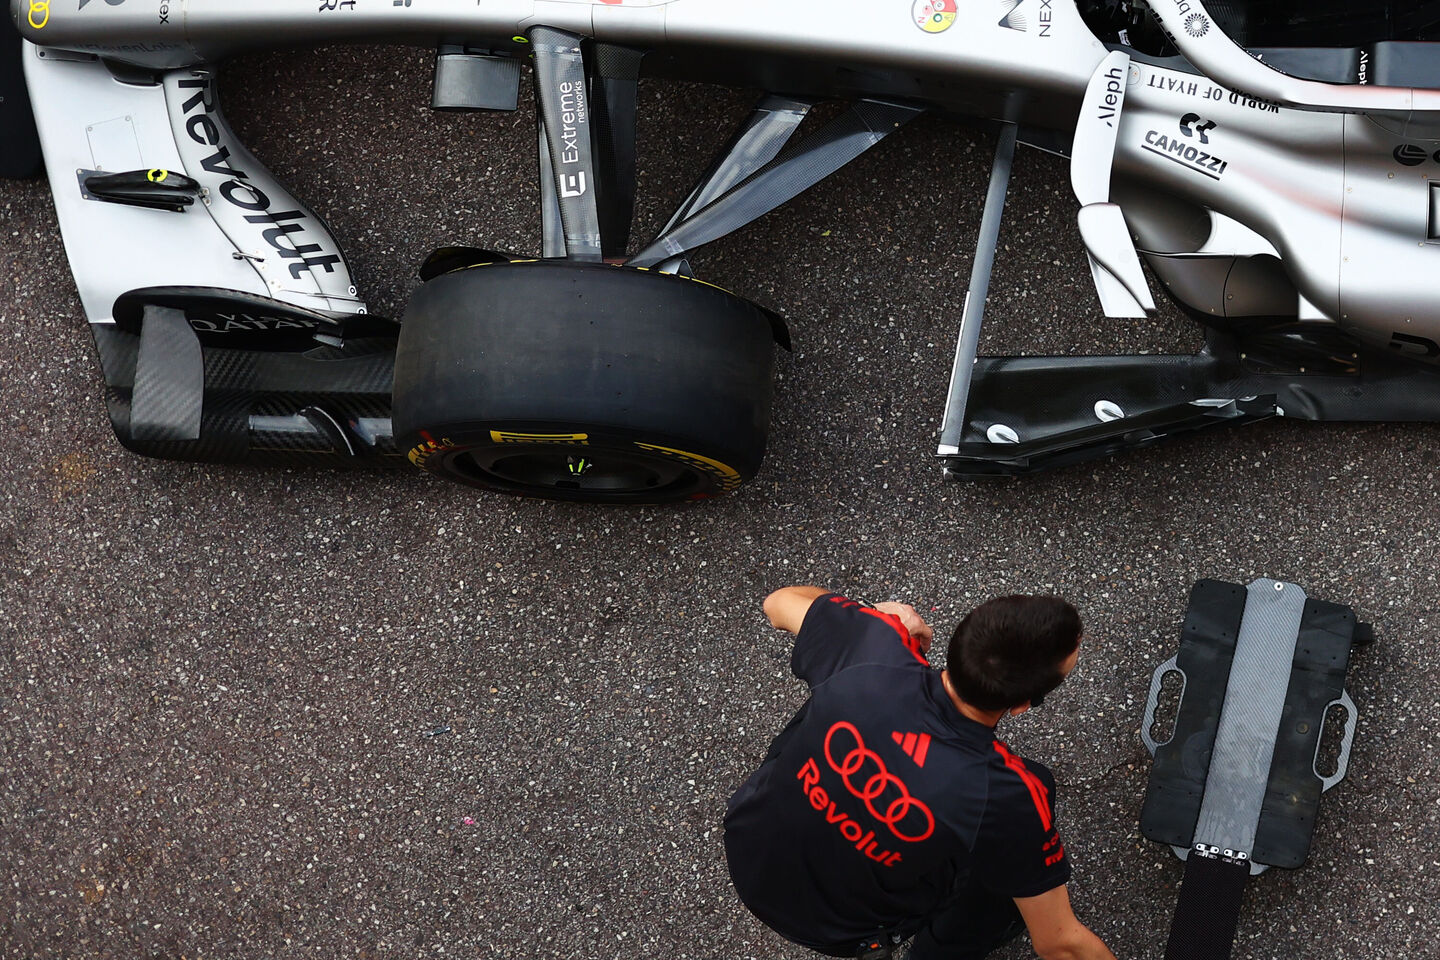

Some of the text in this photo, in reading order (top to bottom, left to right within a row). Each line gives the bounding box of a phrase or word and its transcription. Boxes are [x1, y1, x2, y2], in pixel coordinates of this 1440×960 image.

[574, 80, 585, 123] networks
[1097, 66, 1123, 128] Aleph
[1147, 74, 1197, 96] HYATT
[1203, 83, 1223, 101] OF
[560, 81, 579, 164] Extreme
[1145, 129, 1228, 175] CAMOZZI
[178, 79, 341, 280] Revolut
[797, 757, 903, 867] Revolut
